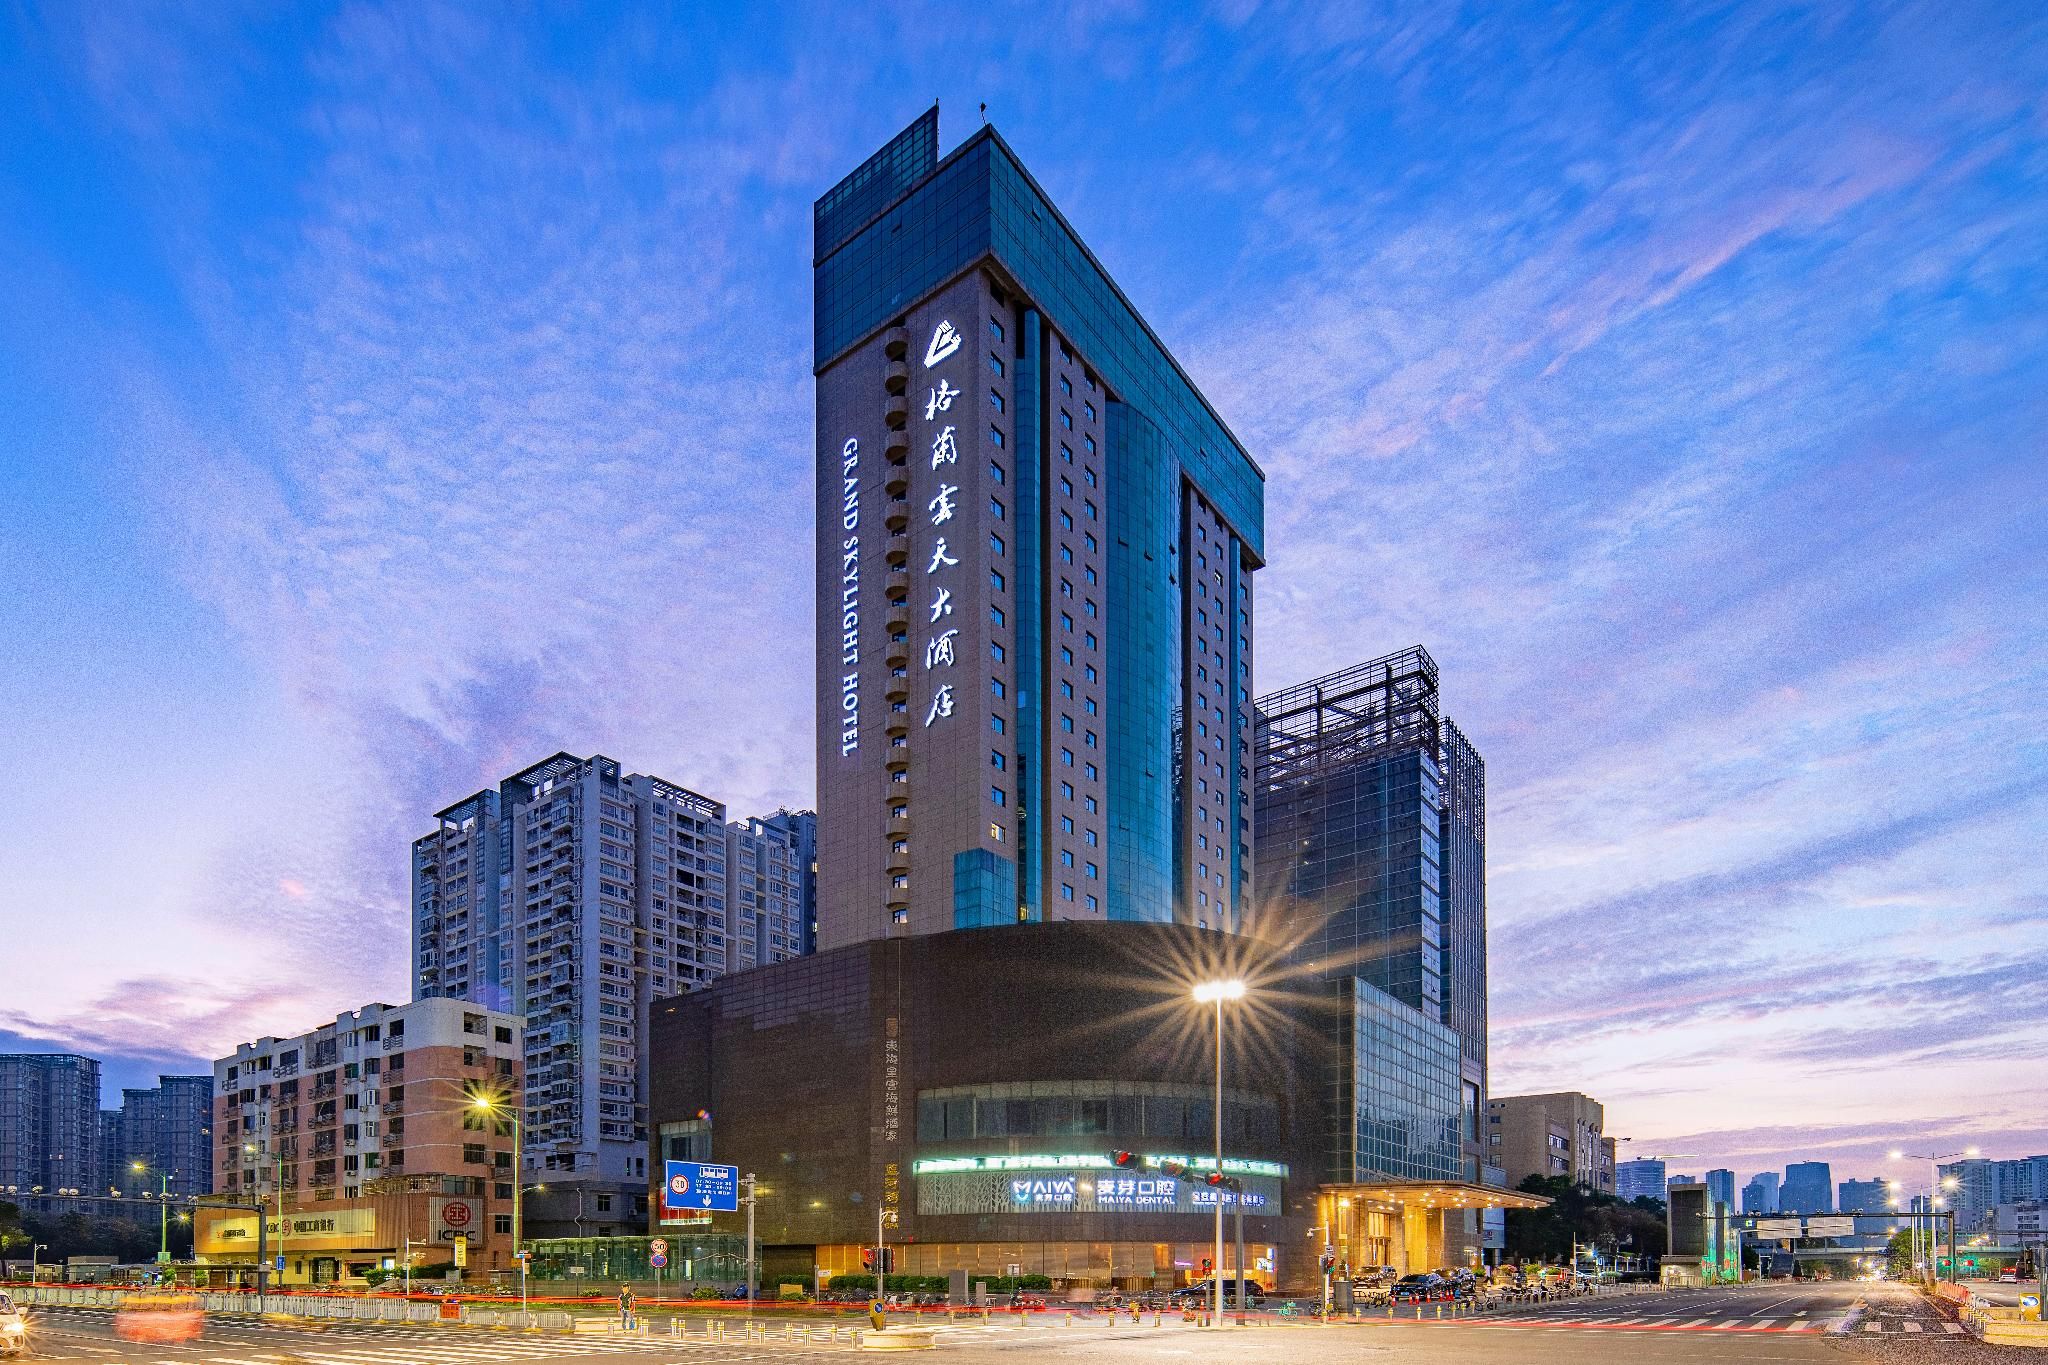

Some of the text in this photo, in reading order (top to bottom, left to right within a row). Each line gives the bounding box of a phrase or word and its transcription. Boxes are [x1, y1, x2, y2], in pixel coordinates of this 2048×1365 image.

[843, 437, 859, 757] GRAND SKYLIGHT HOTEL
[675, 1180, 685, 1189] 30
[1097, 1180, 1176, 1195] 麦芽口腔
[1098, 1195, 1176, 1205] MAIYA DENTAL
